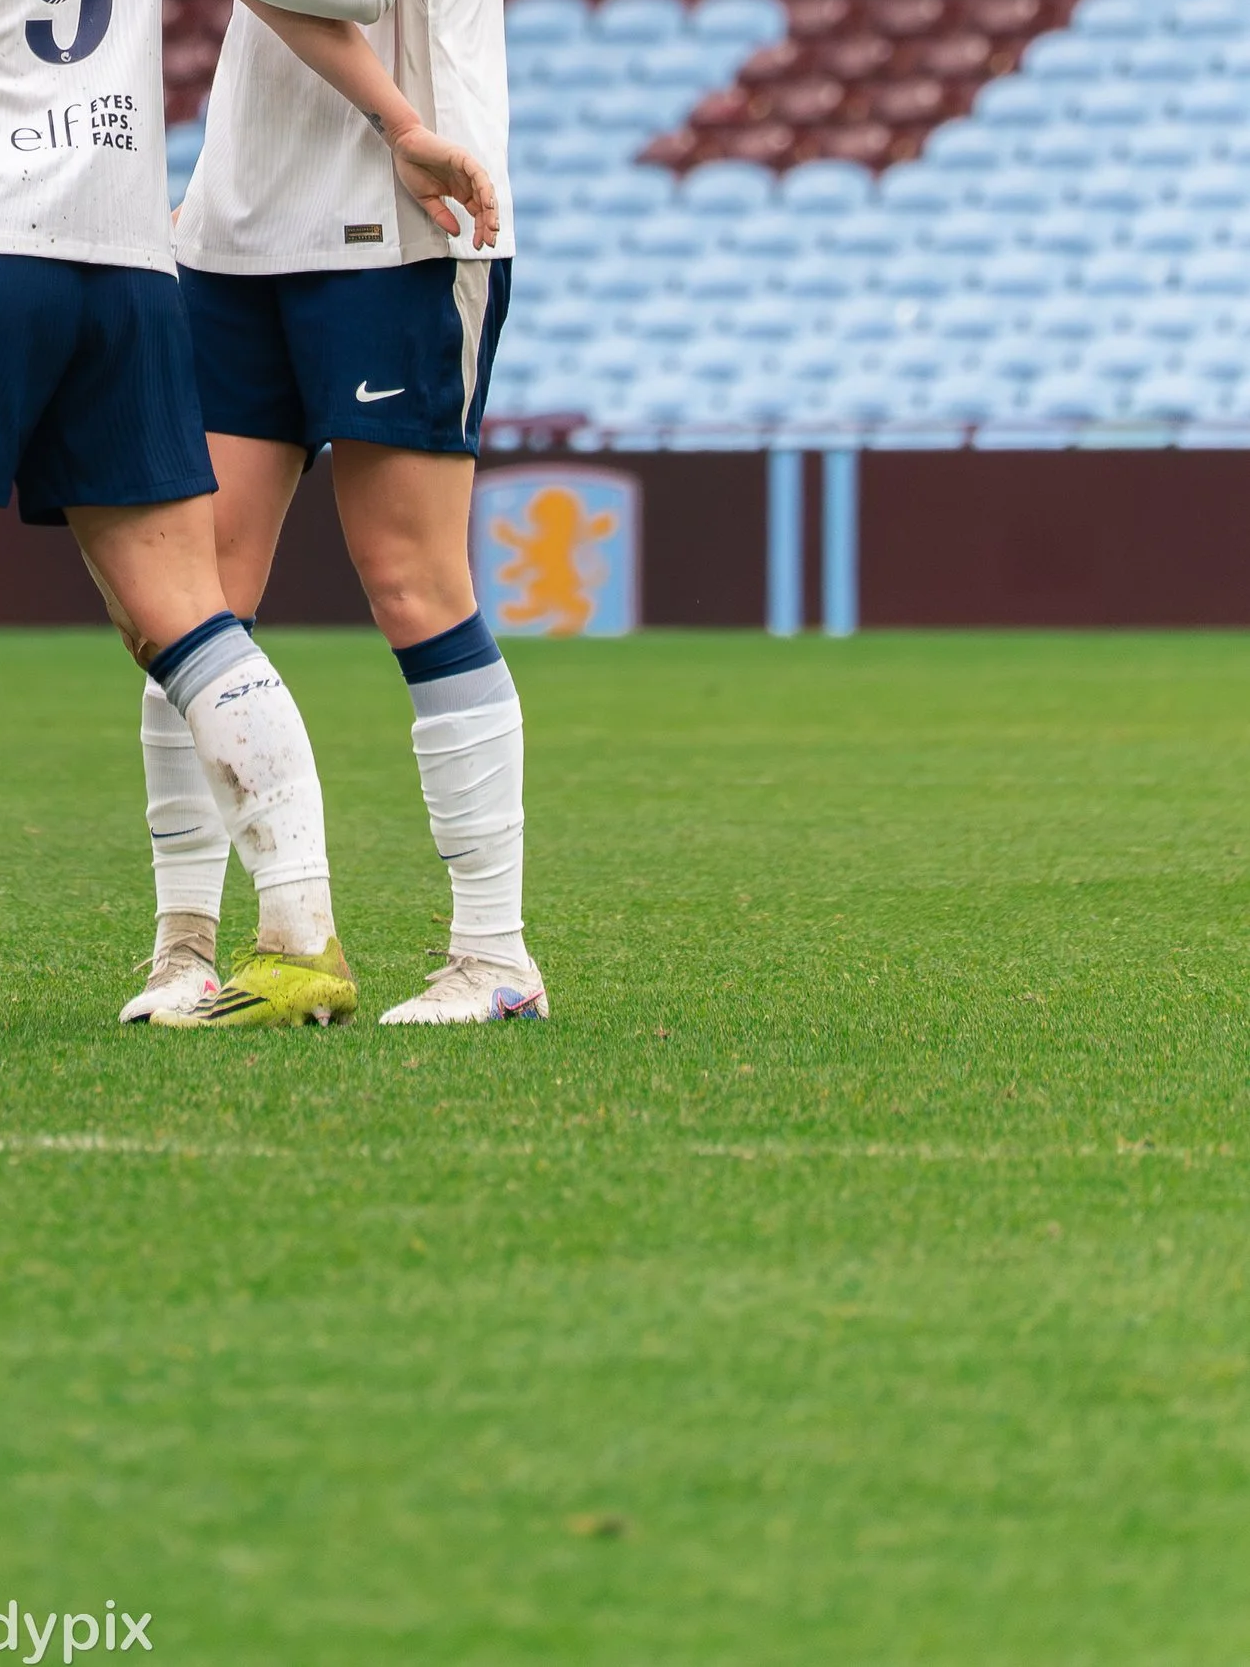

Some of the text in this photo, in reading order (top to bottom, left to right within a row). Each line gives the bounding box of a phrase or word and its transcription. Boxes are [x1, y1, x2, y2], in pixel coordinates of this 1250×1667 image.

[90, 94, 138, 114] EYES.
[91, 113, 133, 131] LIPS.
[92, 131, 138, 152] FACE.
